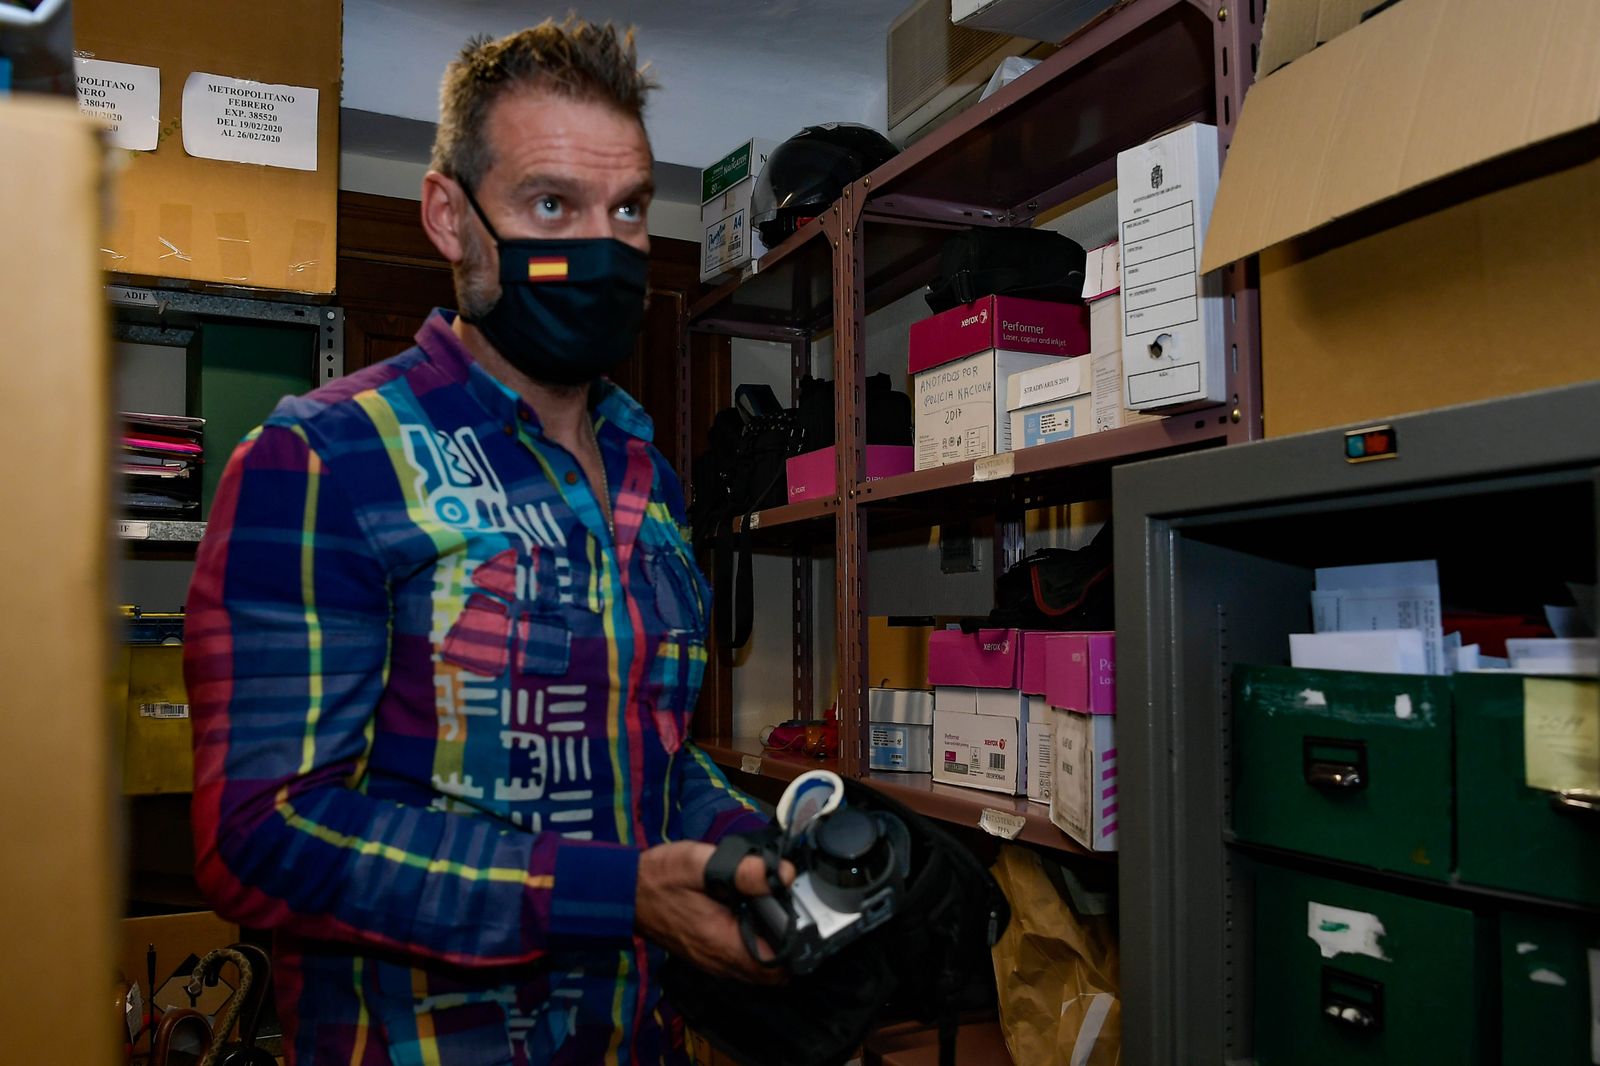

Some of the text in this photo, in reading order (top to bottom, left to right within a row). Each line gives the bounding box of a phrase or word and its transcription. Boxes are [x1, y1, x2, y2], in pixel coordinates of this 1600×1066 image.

[76, 76, 135, 91] POLITANO
[207, 84, 295, 103] METROPOLITANO
[84, 98, 116, 110] 380470
[228, 98, 275, 111] FEBRERO
[225, 108, 278, 122] EXP. 385520
[216, 117, 283, 133] DEL 19/02/2020
[221, 129, 281, 143] AL 26/02/2020
[124, 291, 149, 300] ADIF
[960, 314, 979, 328] xerox
[1002, 320, 1045, 334] Performer
[1020, 336, 1038, 344] copier
[1038, 337, 1050, 345] and
[1050, 337, 1067, 347] inkjet
[920, 366, 978, 394] ANOTADOS POR
[1023, 378, 1059, 394] STRADIVARIUS
[944, 408, 962, 425] 2017
[983, 642, 1001, 651] xerox
[984, 739, 999, 747] xerox
